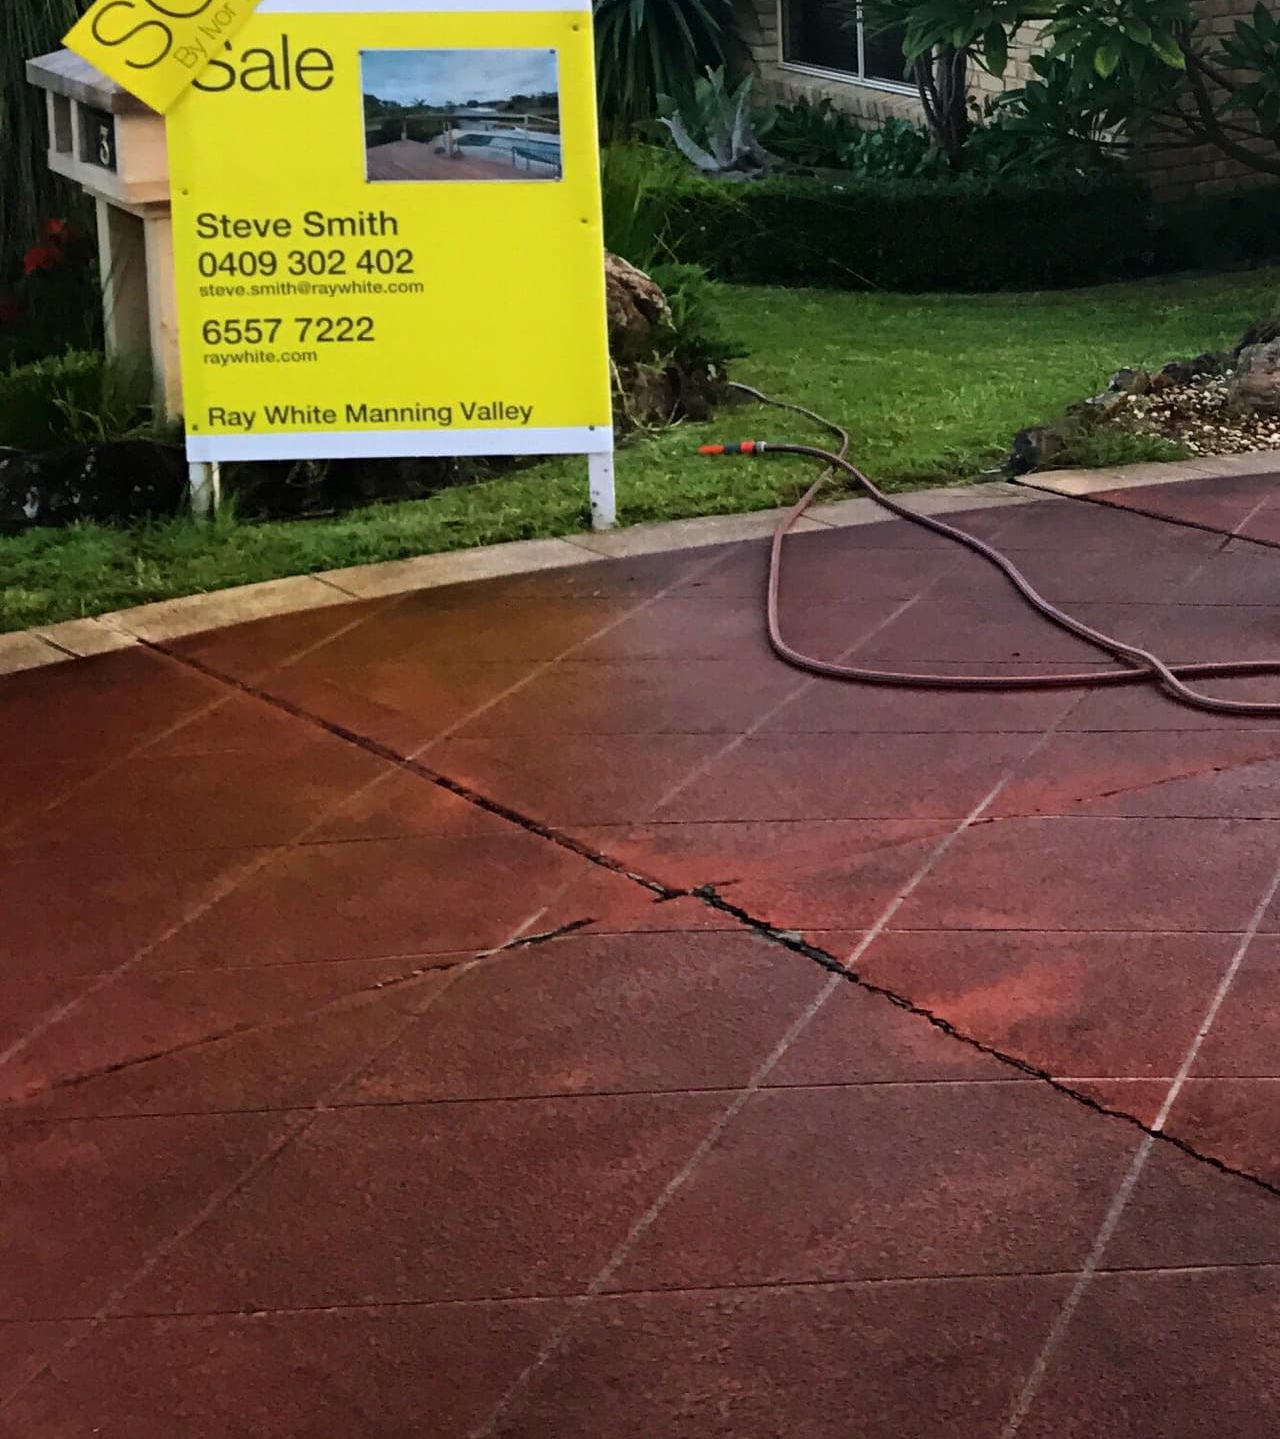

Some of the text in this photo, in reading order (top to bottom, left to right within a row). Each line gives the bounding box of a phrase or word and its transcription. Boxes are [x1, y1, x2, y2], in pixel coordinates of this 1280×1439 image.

[173, 37, 208, 69] By
[197, 1, 236, 41] Ivor
[196, 210, 398, 239] Steve Smith
[198, 248, 414, 278] 0409 302 402
[199, 279, 424, 297] steve.smith@raywhite.com
[202, 316, 375, 345] 6557 7222
[204, 349, 317, 367] raywhite.com
[208, 401, 533, 430] Ray White Manning Valley
